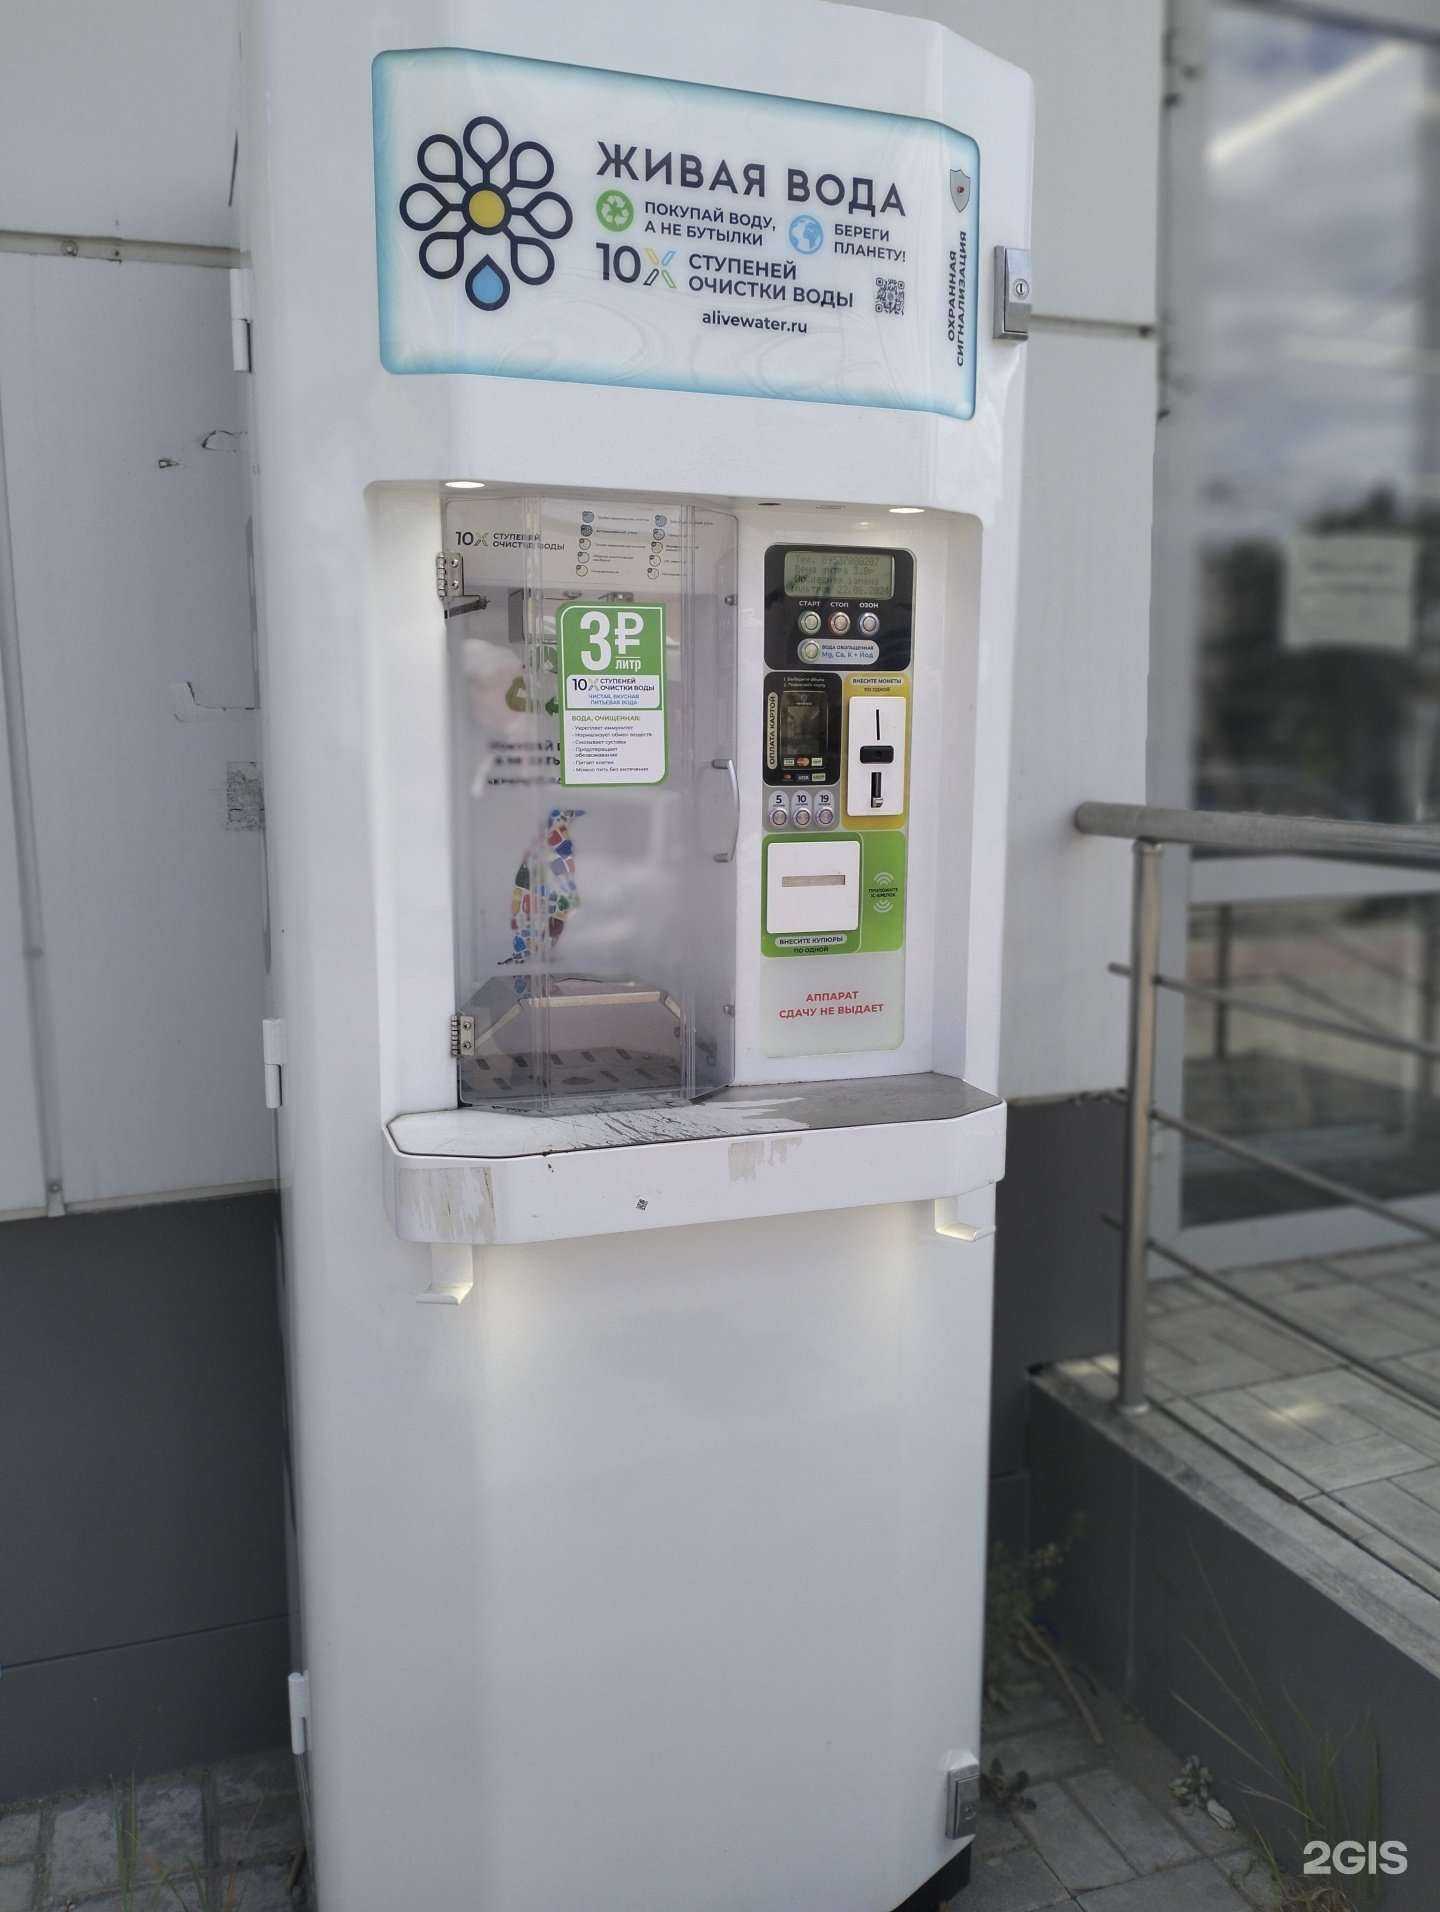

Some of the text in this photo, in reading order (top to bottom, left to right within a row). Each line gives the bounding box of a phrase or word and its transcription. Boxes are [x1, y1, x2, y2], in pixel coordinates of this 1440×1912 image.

[596, 140, 906, 218] ЖИВАЯ ВОДА
[645, 201, 776, 232] ПОКУПАЙ ВОДУ,
[644, 220, 763, 246] А НЕ БУТЫЛКИ
[834, 223, 890, 242] БЕРЕГИ
[834, 241, 906, 262] ПЛАНЕТУ!
[688, 252, 797, 281] СТУПЕНЕЙ
[688, 275, 854, 308] ОЧИСТКИ ВОДЫ
[947, 250, 957, 342] ОХРАННАЯ
[957, 230, 967, 367] СИГНАЛИЗАЦИЯ
[702, 310, 808, 334] alivewater.ru
[768, 695, 778, 765] ОПЛАТА КАРТОЙ
[775, 794, 783, 804] 5
[796, 794, 807, 803] 10
[819, 794, 830, 803] 19
[812, 936, 844, 944] КУПЮРЫ
[805, 990, 860, 1002] АППАРАТ
[779, 1003, 885, 1019] СДАЧУ НЕ ВЫДАЕТ
